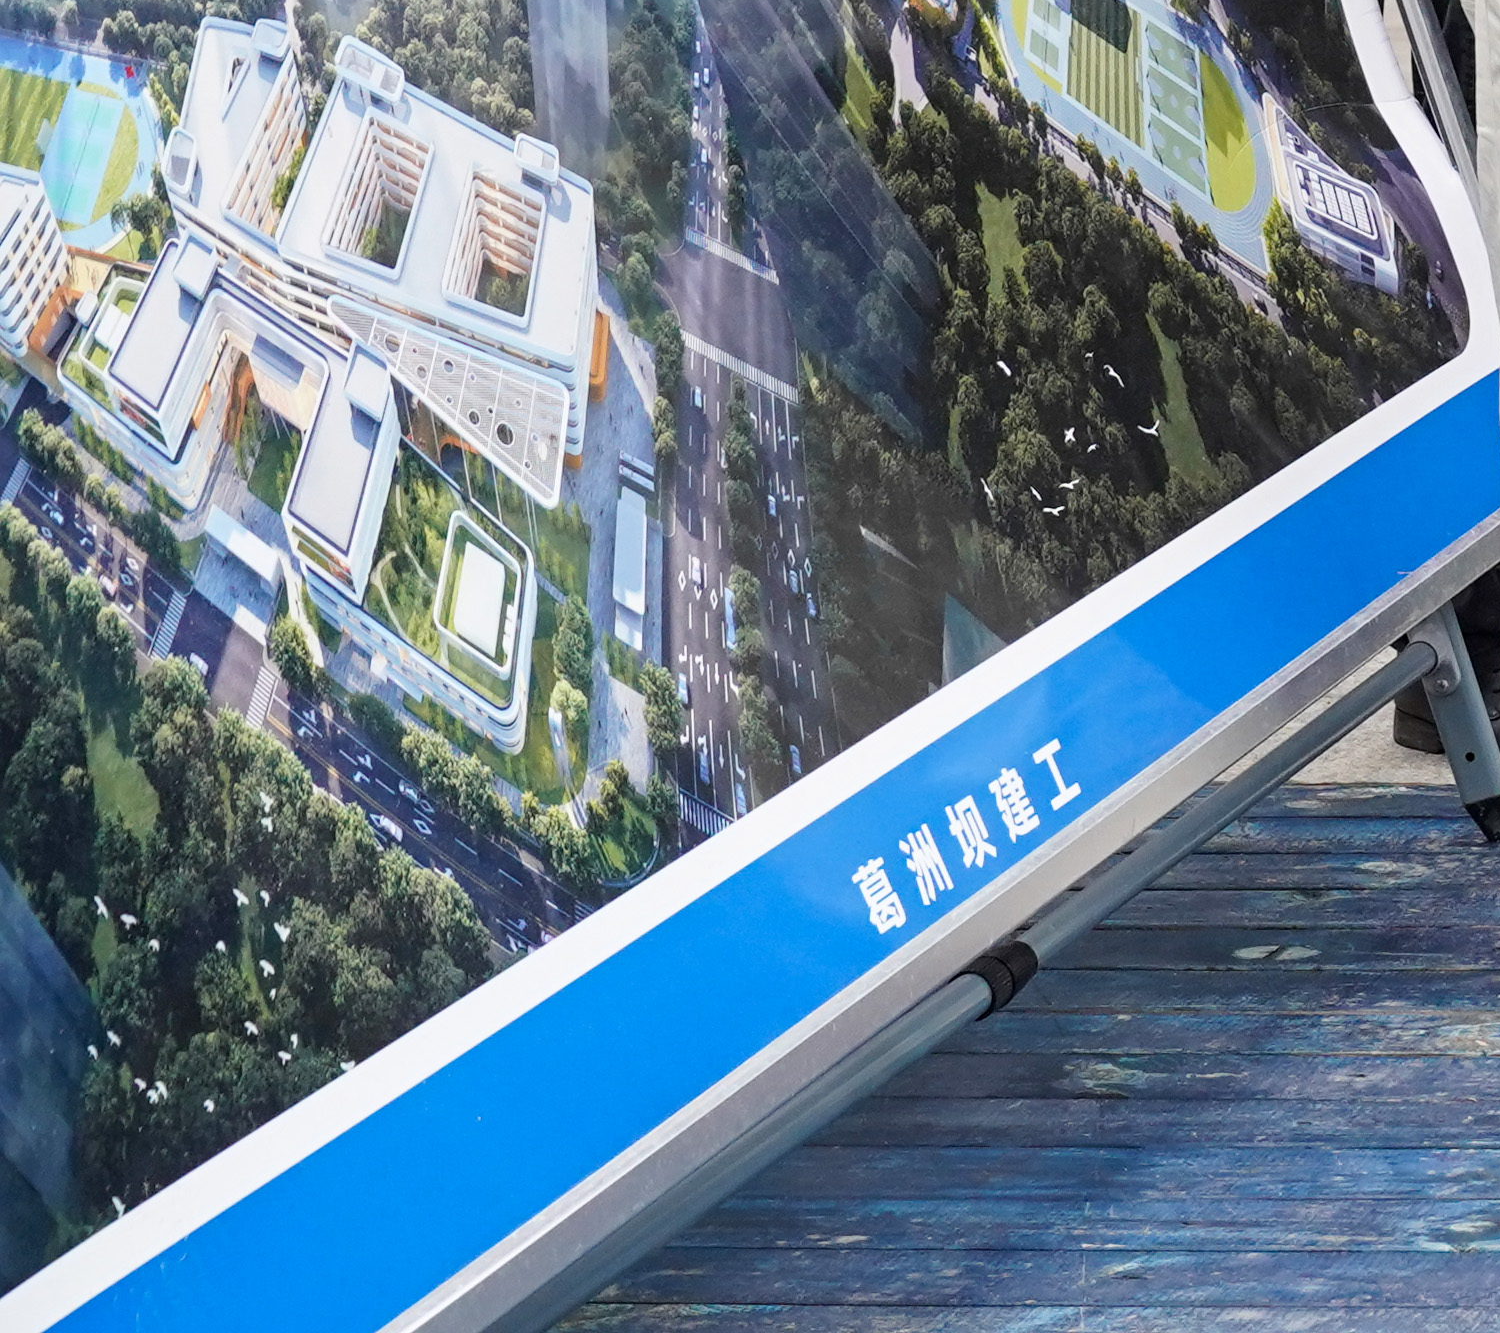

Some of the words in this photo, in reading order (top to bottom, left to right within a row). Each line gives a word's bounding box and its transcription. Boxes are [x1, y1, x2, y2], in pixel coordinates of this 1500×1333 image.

[850, 735, 1083, 936] 葛洲坝建工
